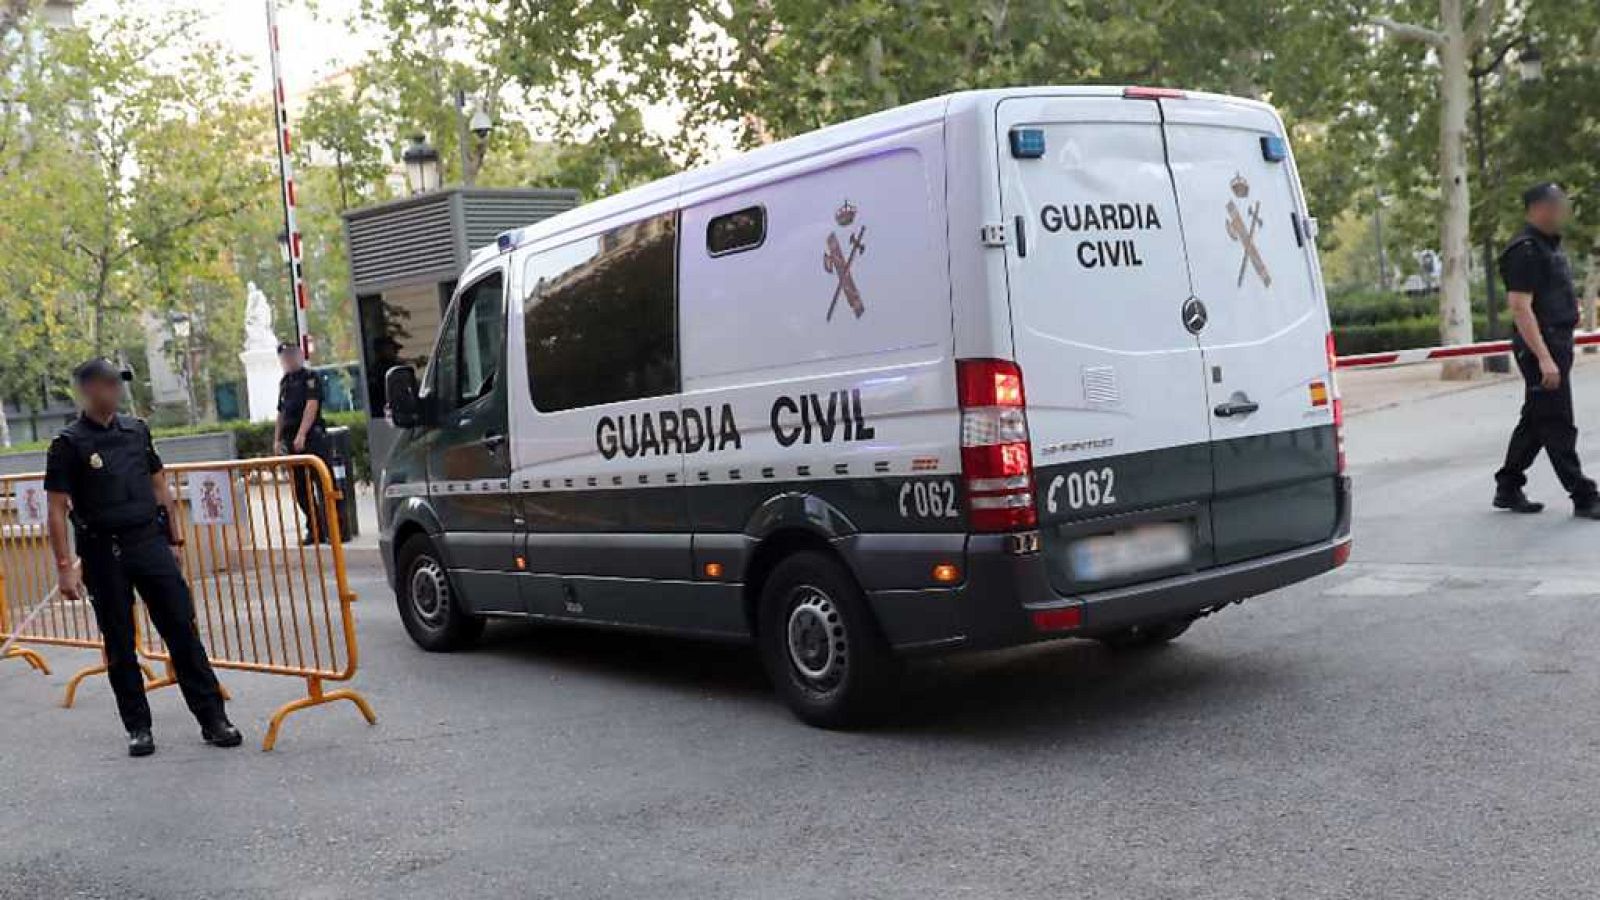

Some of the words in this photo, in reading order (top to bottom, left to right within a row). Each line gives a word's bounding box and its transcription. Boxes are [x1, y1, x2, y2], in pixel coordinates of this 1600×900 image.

[1040, 203, 1162, 233] GUARDIA
[1077, 240, 1143, 268] CIVIL
[596, 403, 741, 459] GUARDIA
[770, 389, 875, 447] CIVIL
[914, 482, 959, 517] 062
[1066, 467, 1116, 508] 062
